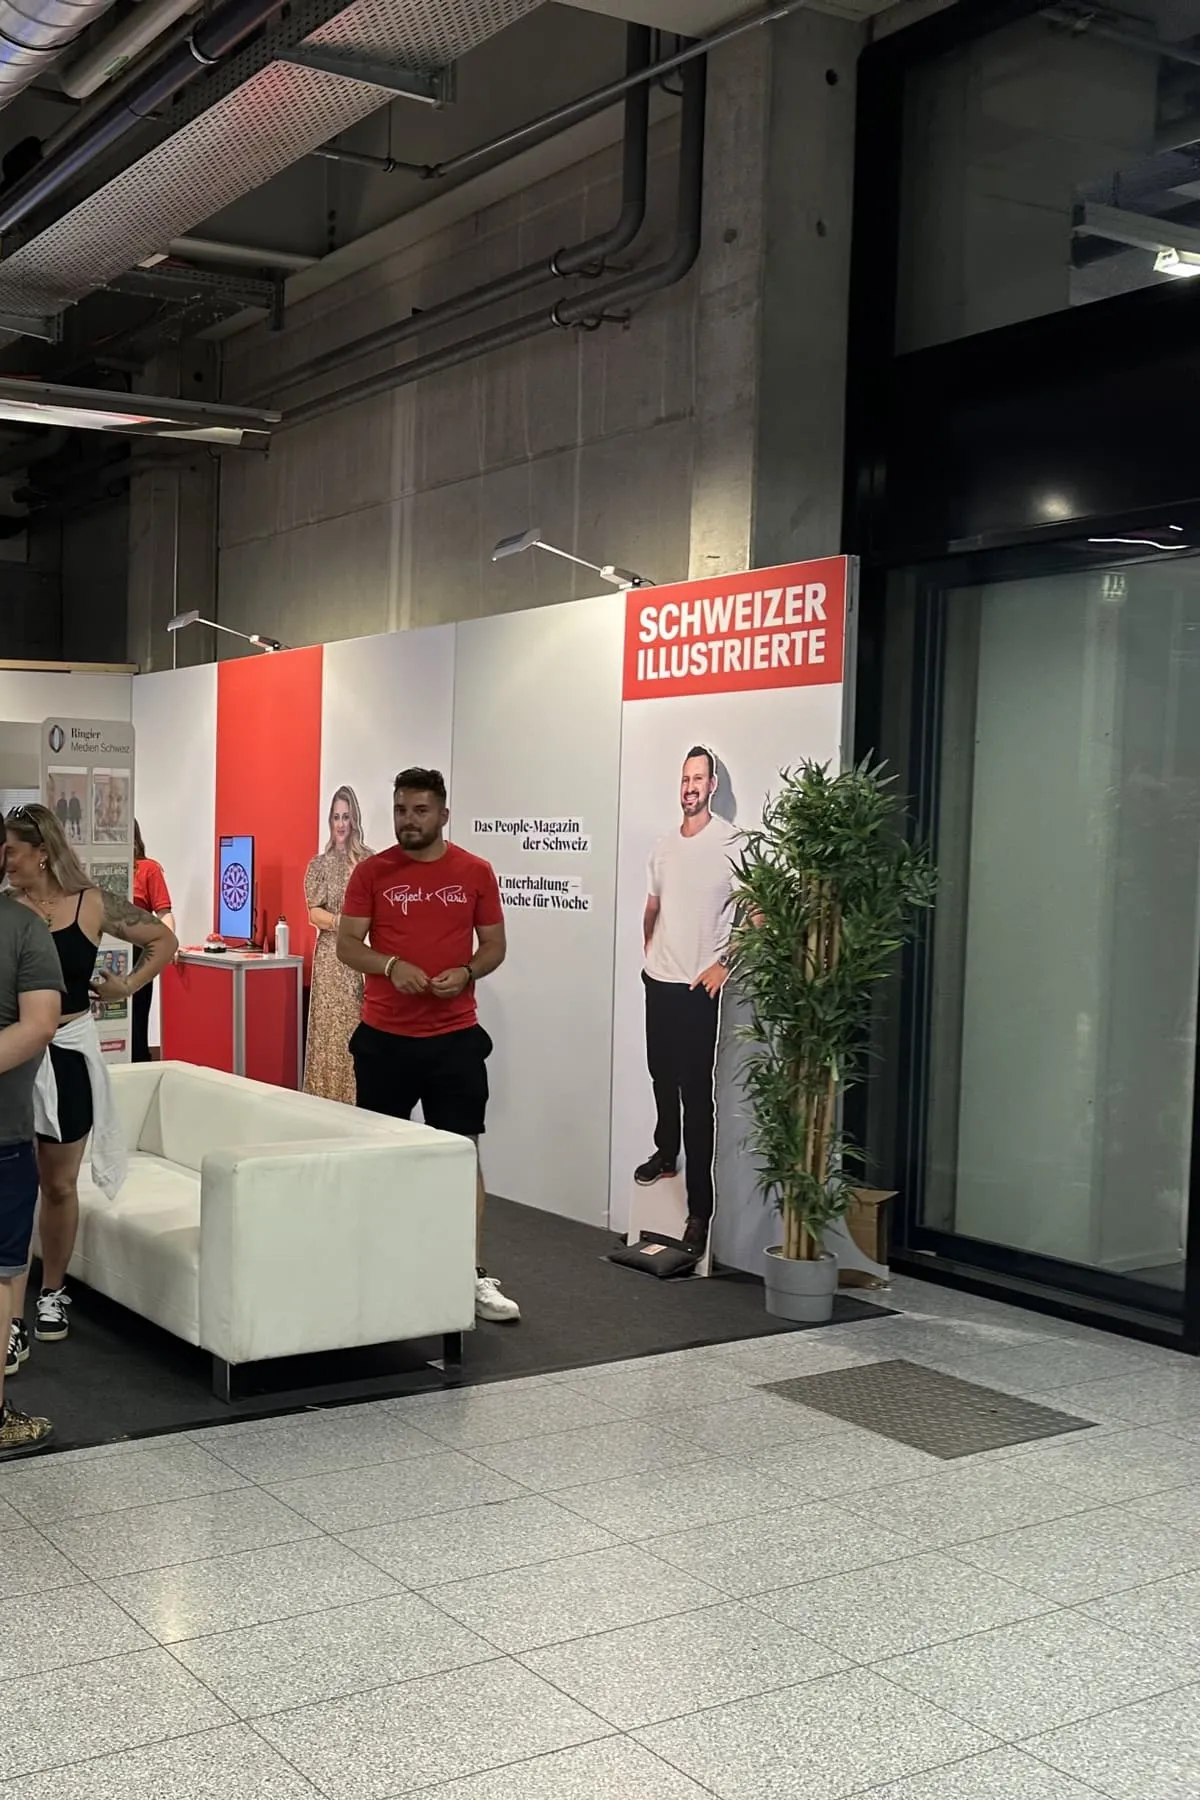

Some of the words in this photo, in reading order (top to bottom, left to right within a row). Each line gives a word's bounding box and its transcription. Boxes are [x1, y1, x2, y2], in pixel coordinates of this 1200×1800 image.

[638, 583, 828, 643] SCHWEIZER
[637, 628, 826, 680] ILLUSTRIERTE
[71, 727, 101, 742] Ringier
[71, 742, 99, 753] Medien
[100, 743, 130, 753] Schweiz
[474, 820, 493, 833] Das
[495, 819, 580, 836] People-Magazin
[522, 837, 541, 850] der
[542, 837, 588, 851] Schweiz
[498, 875, 569, 894] Unterhaltung
[383, 885, 423, 915] Project
[435, 885, 467, 907] Paris
[533, 893, 550, 908] für
[551, 895, 589, 910] Woche
